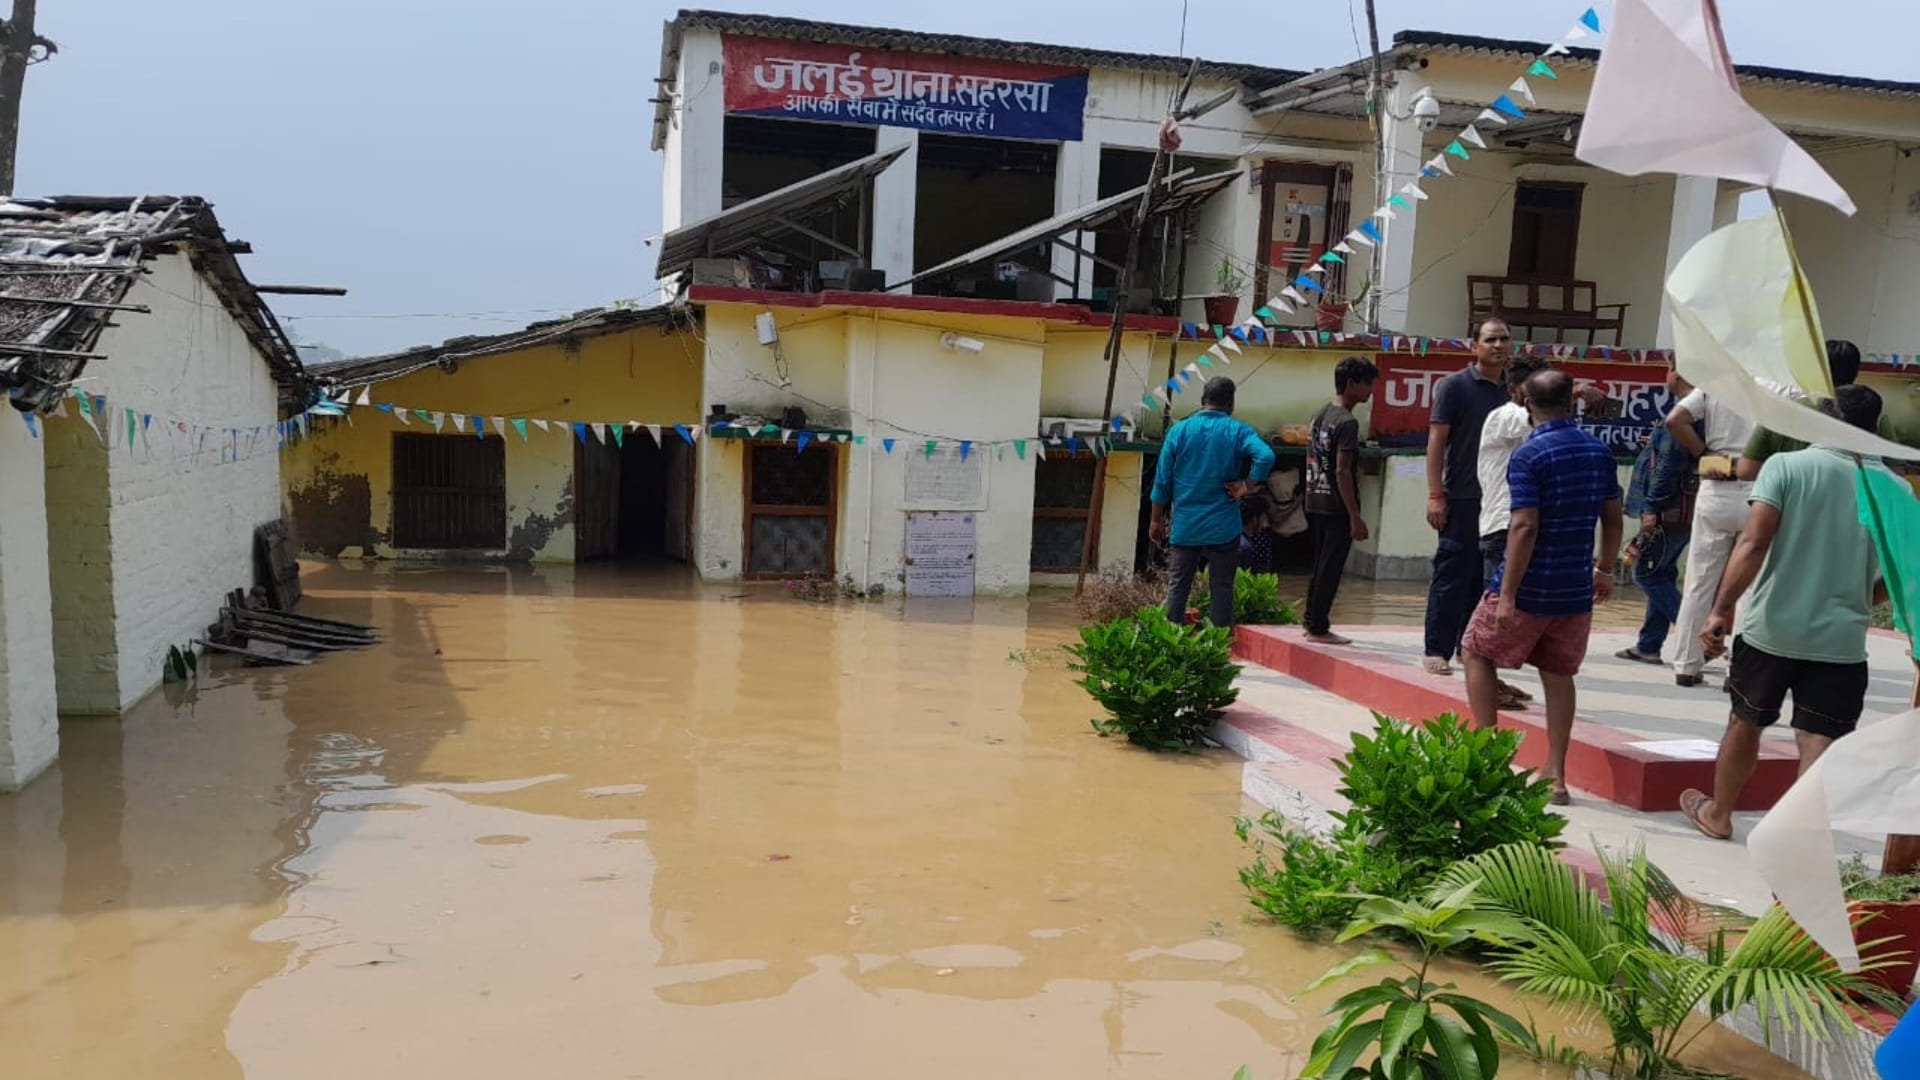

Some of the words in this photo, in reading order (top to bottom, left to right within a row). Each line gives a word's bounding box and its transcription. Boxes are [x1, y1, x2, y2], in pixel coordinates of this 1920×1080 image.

[754, 52, 867, 96] जलई
[955, 75, 1054, 113] सहरसा
[783, 94, 839, 115] आपकी
[901, 99, 935, 124] सदैव
[938, 108, 976, 131] तत्पर
